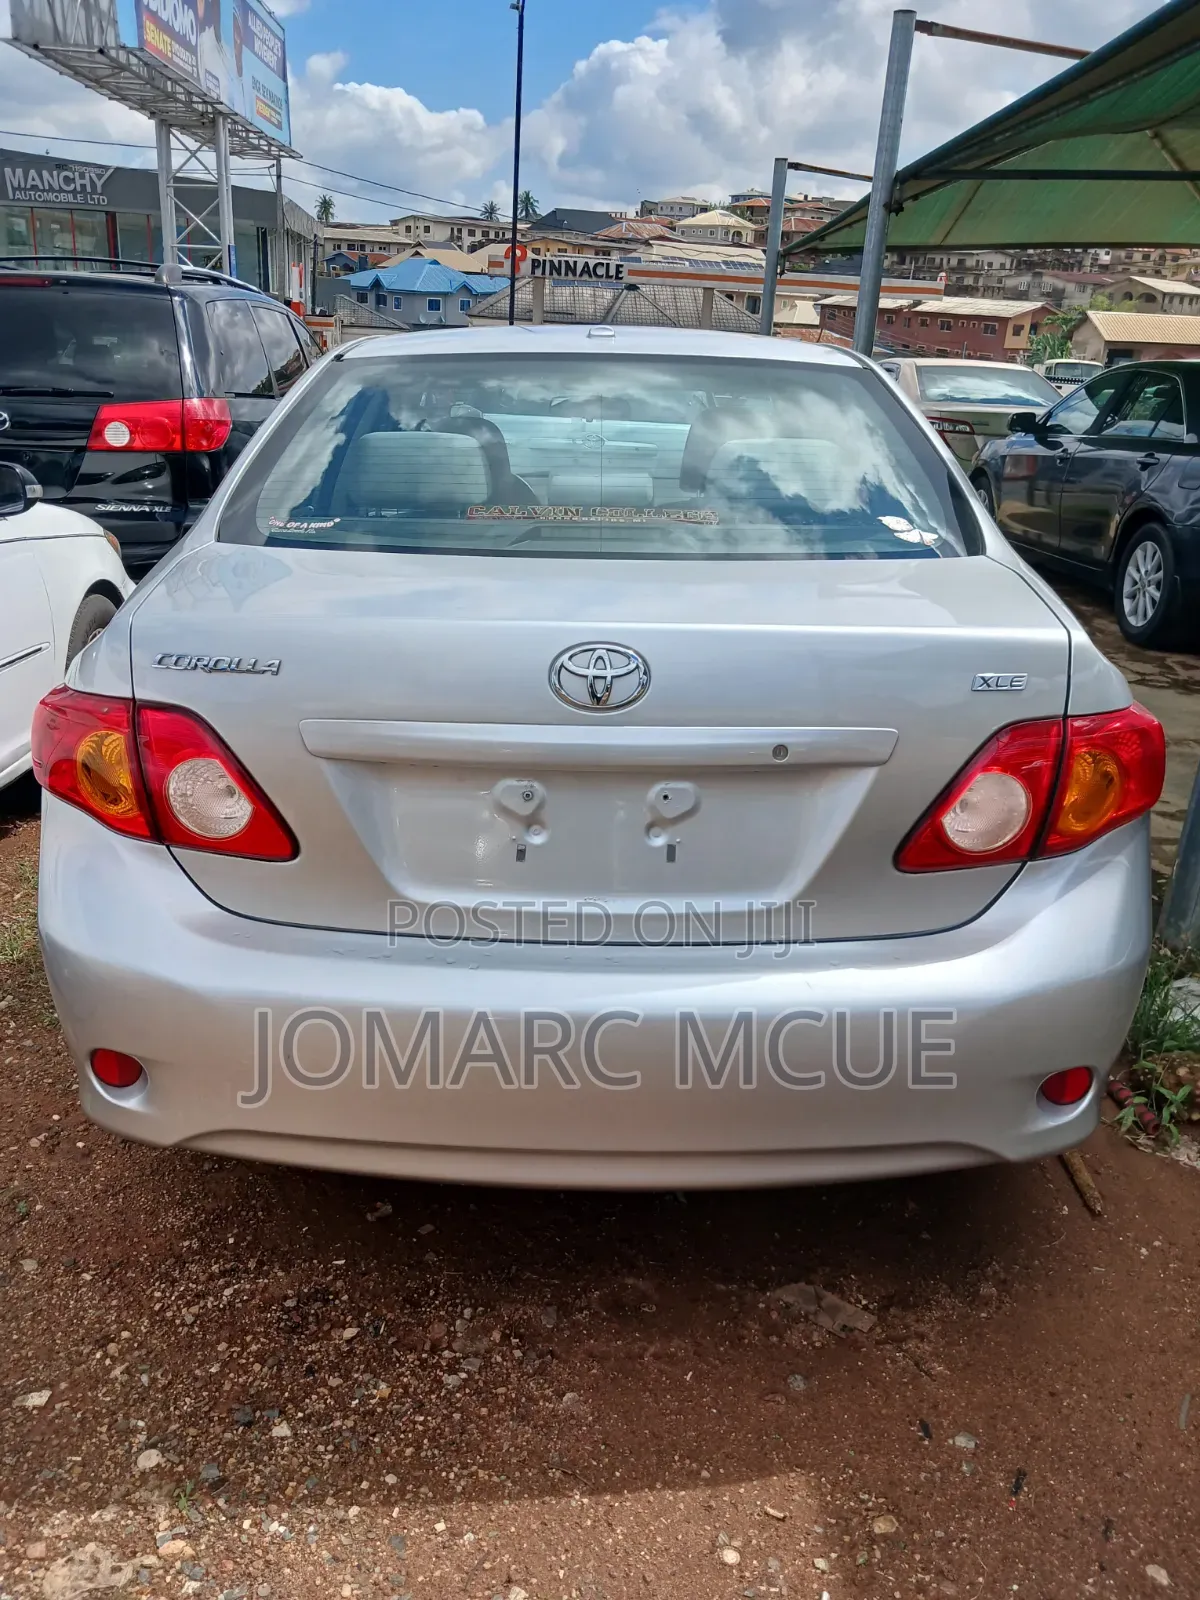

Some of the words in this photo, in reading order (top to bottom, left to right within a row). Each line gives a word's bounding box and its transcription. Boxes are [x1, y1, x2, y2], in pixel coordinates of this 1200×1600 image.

[4, 166, 117, 199] MANCHY
[14, 191, 85, 203] AUTOMOBILE
[87, 194, 108, 205] LTD
[530, 258, 624, 281] PINNACLE
[95, 504, 150, 512] SIENNA
[152, 505, 172, 513] XLE
[467, 505, 583, 517] CALVIN
[151, 653, 282, 676] COROLLA
[974, 674, 1027, 690] XLE
